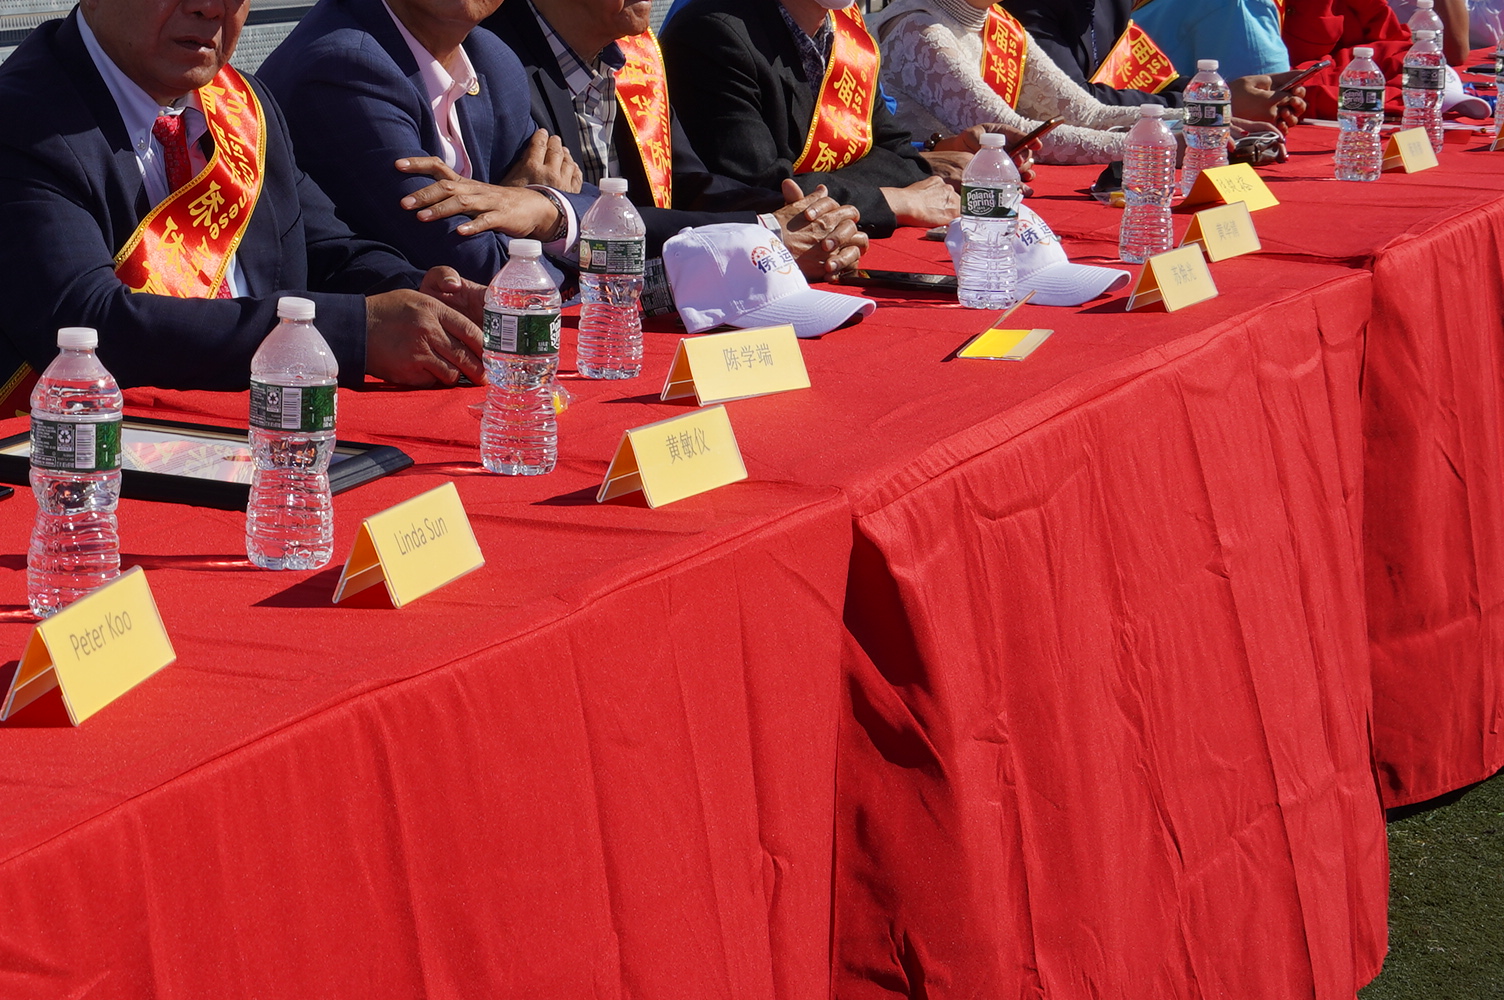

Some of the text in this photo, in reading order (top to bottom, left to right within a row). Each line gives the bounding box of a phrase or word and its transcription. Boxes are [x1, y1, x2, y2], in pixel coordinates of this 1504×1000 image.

[1004, 32, 1020, 104] 1st Chine
[1146, 54, 1169, 75] 1st
[226, 87, 249, 128] The
[851, 86, 867, 115] 1st
[229, 133, 250, 164] 1st
[967, 190, 995, 202] Poland
[968, 199, 995, 212] Spring
[722, 342, 775, 373] 陈学端
[665, 426, 711, 465] 黄敏仪
[393, 513, 450, 557] Linda Sun
[69, 609, 133, 662] Peter Koo
